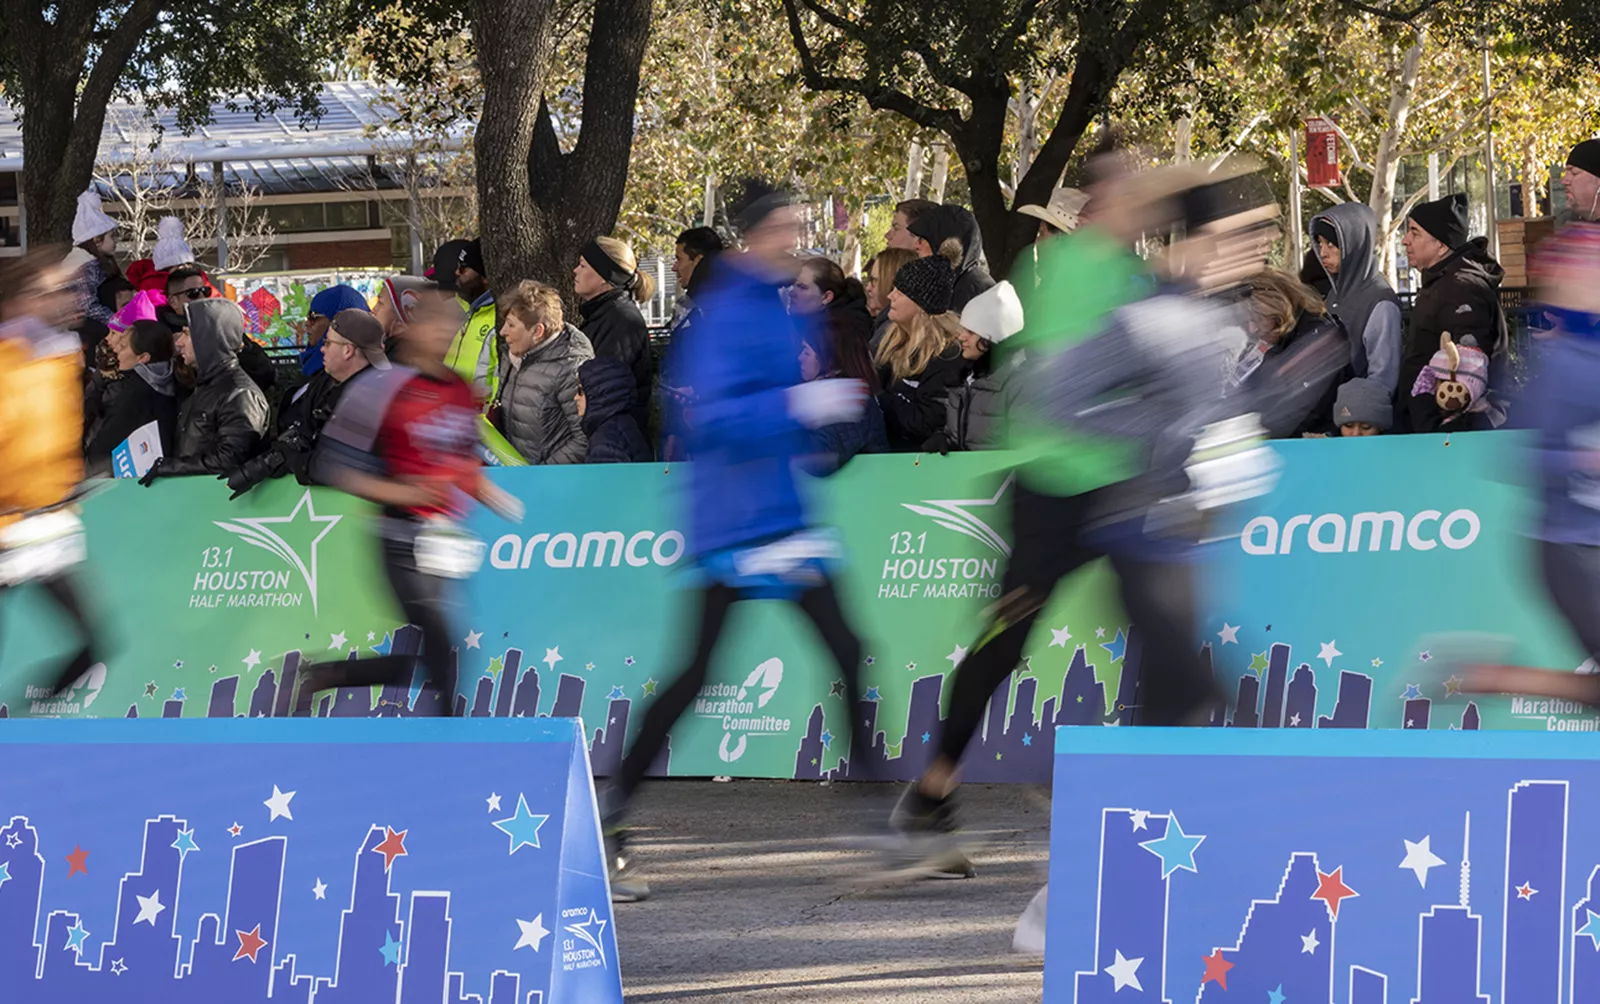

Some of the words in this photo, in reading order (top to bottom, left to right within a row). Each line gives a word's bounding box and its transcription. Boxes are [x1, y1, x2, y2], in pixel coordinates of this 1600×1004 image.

[1241, 509, 1481, 555] aramco
[490, 530, 685, 569] aramco
[890, 531, 927, 555] 13.1
[202, 546, 233, 567] 13.1
[882, 558, 997, 579] HOUSTON
[193, 570, 290, 590] HOUSTON
[878, 583, 920, 598] HALF
[923, 583, 1002, 598] MARATHO
[189, 594, 224, 608] HALF
[227, 593, 302, 607] MARATHON
[30, 700, 80, 714] Marathon
[695, 699, 753, 714] Marathon
[1511, 697, 1583, 714] Marathon
[722, 715, 790, 731] Committee
[562, 907, 588, 917] aramco
[563, 949, 595, 962] HOUSTON
